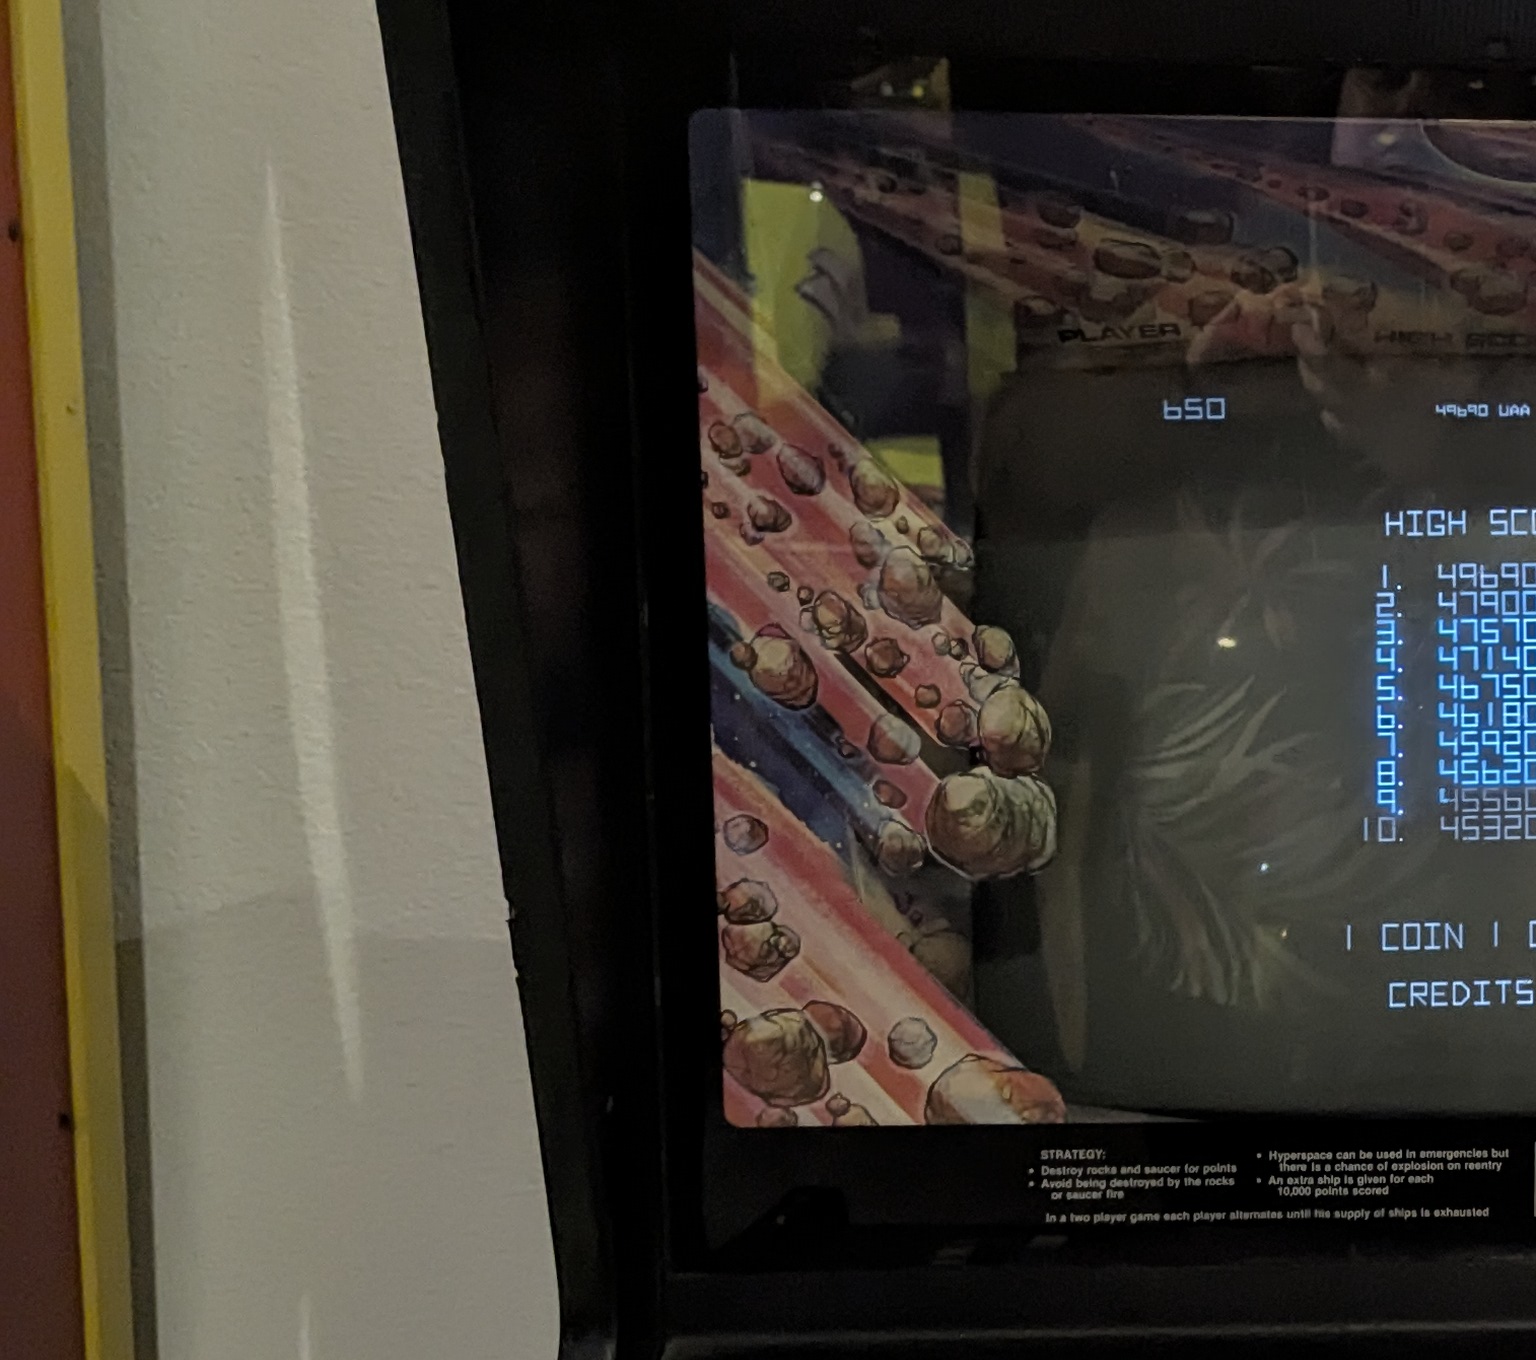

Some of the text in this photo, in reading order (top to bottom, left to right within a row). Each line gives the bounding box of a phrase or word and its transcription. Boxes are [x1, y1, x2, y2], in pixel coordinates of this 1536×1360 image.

[1058, 323, 1181, 342] PLAYER
[1163, 398, 1225, 420] 650
[1435, 404, 1531, 417] 49690 UAA
[1385, 509, 1466, 536] HIGH
[1382, 564, 1402, 590] 1.
[1376, 592, 1402, 618] 2.
[1376, 620, 1403, 645] 3.
[1376, 648, 1403, 673] 4.
[1376, 675, 1403, 702] 5.
[1376, 704, 1403, 730] 6.
[1376, 732, 1403, 758] 7.
[1376, 760, 1403, 787] 8.
[1376, 789, 1403, 815] 9.
[1363, 816, 1403, 843] 10.
[1380, 921, 1464, 951] COIN
[1388, 979, 1534, 1008] CREDITS
[1040, 1149, 1106, 1160] STRATEGY:
[1268, 1148, 1509, 1162] Hyperspace can be used in emergencies but
[1279, 1160, 1502, 1173] there is a chance of explosion on reentry
[1041, 1162, 1237, 1177] Destroy rocks and saucer for points
[1268, 1173, 1434, 1186] An extra ship is given for each
[1041, 1176, 1235, 1190] Avoid being destroyed by the rocks
[1050, 1189, 1125, 1200] or saucer fire
[1278, 1185, 1389, 1197] 10,000 points scored
[1045, 1213, 1057, 1223] In
[1059, 1214, 1067, 1223] a
[1069, 1213, 1091, 1223] two
[1094, 1212, 1127, 1224] player
[1129, 1213, 1160, 1224] game
[1163, 1211, 1190, 1221] each
[1193, 1210, 1226, 1222] player
[1229, 1210, 1283, 1220] alternates
[1286, 1208, 1311, 1219] until
[1334, 1208, 1371, 1220] supply
[1374, 1207, 1385, 1218] of
[1388, 1207, 1417, 1221] ships
[1420, 1207, 1431, 1218] is
[1433, 1207, 1490, 1218] exhausted
